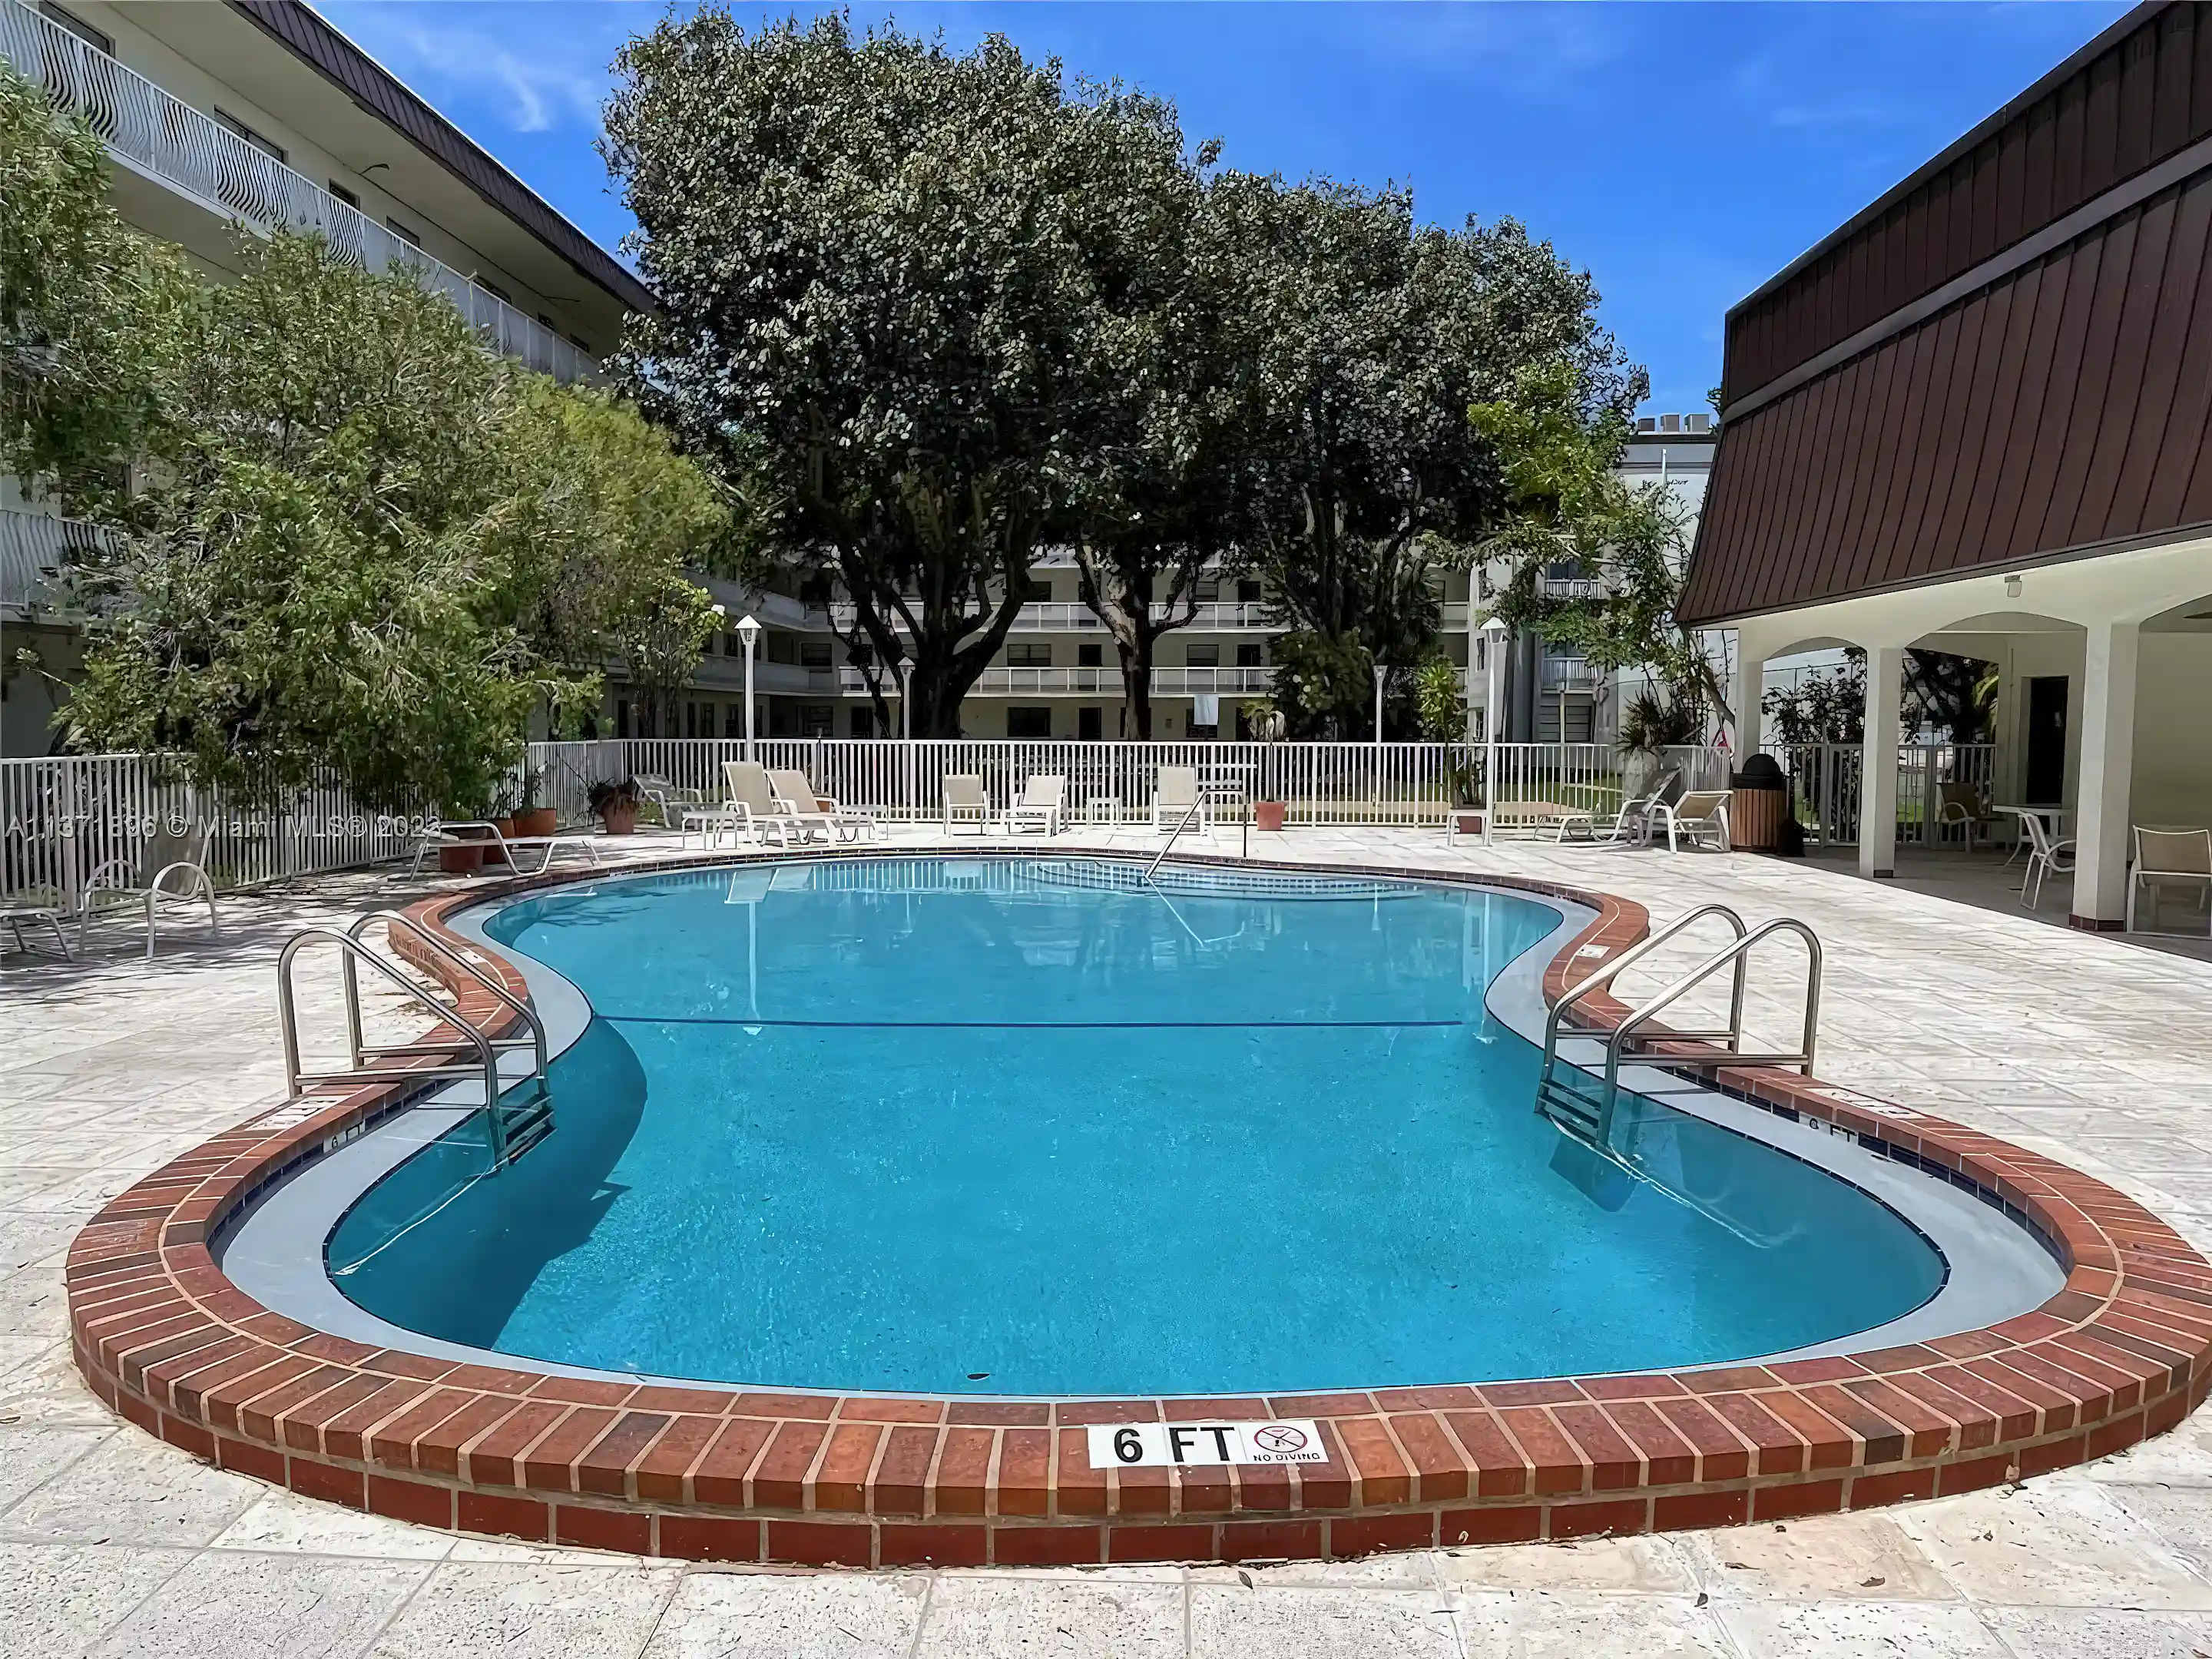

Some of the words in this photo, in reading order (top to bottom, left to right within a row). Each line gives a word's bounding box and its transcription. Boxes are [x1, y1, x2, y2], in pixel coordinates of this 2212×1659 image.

[1114, 1428, 1144, 1463] 6
[1168, 1426, 1235, 1462] FT
[1276, 1452, 1321, 1462] DIVING
